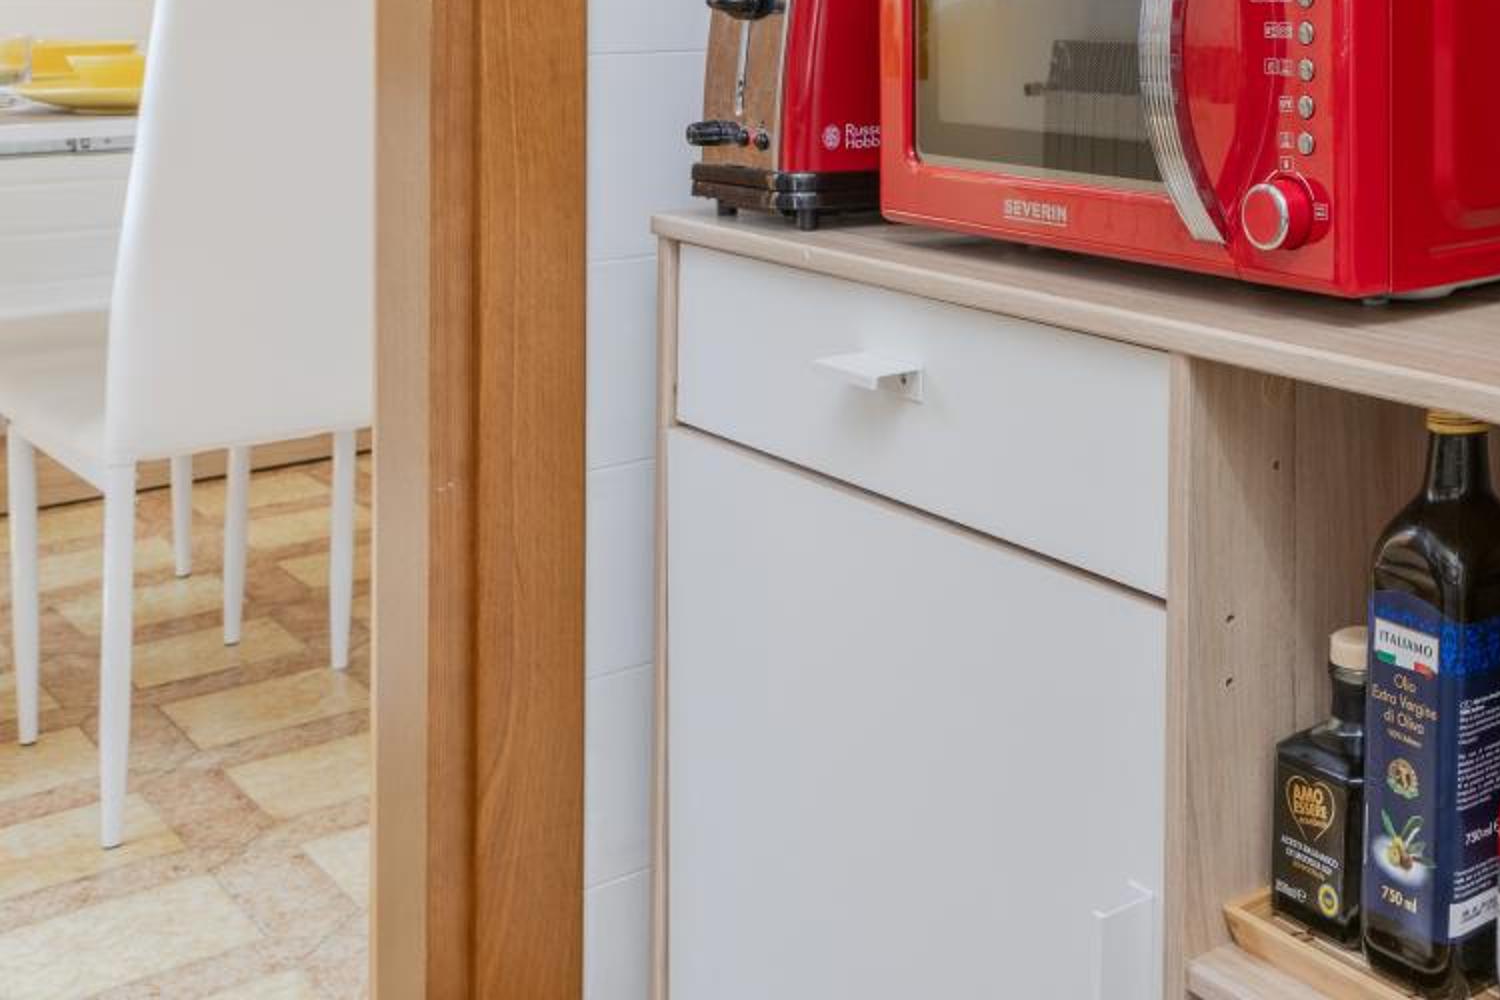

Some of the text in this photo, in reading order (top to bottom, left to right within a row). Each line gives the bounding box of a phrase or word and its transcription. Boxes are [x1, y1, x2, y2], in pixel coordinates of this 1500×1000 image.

[1003, 199, 1067, 224] SEVERIN
[1379, 631, 1433, 658] ITALIAMO
[1394, 673, 1417, 693] Olio
[1380, 884, 1404, 906] 750
